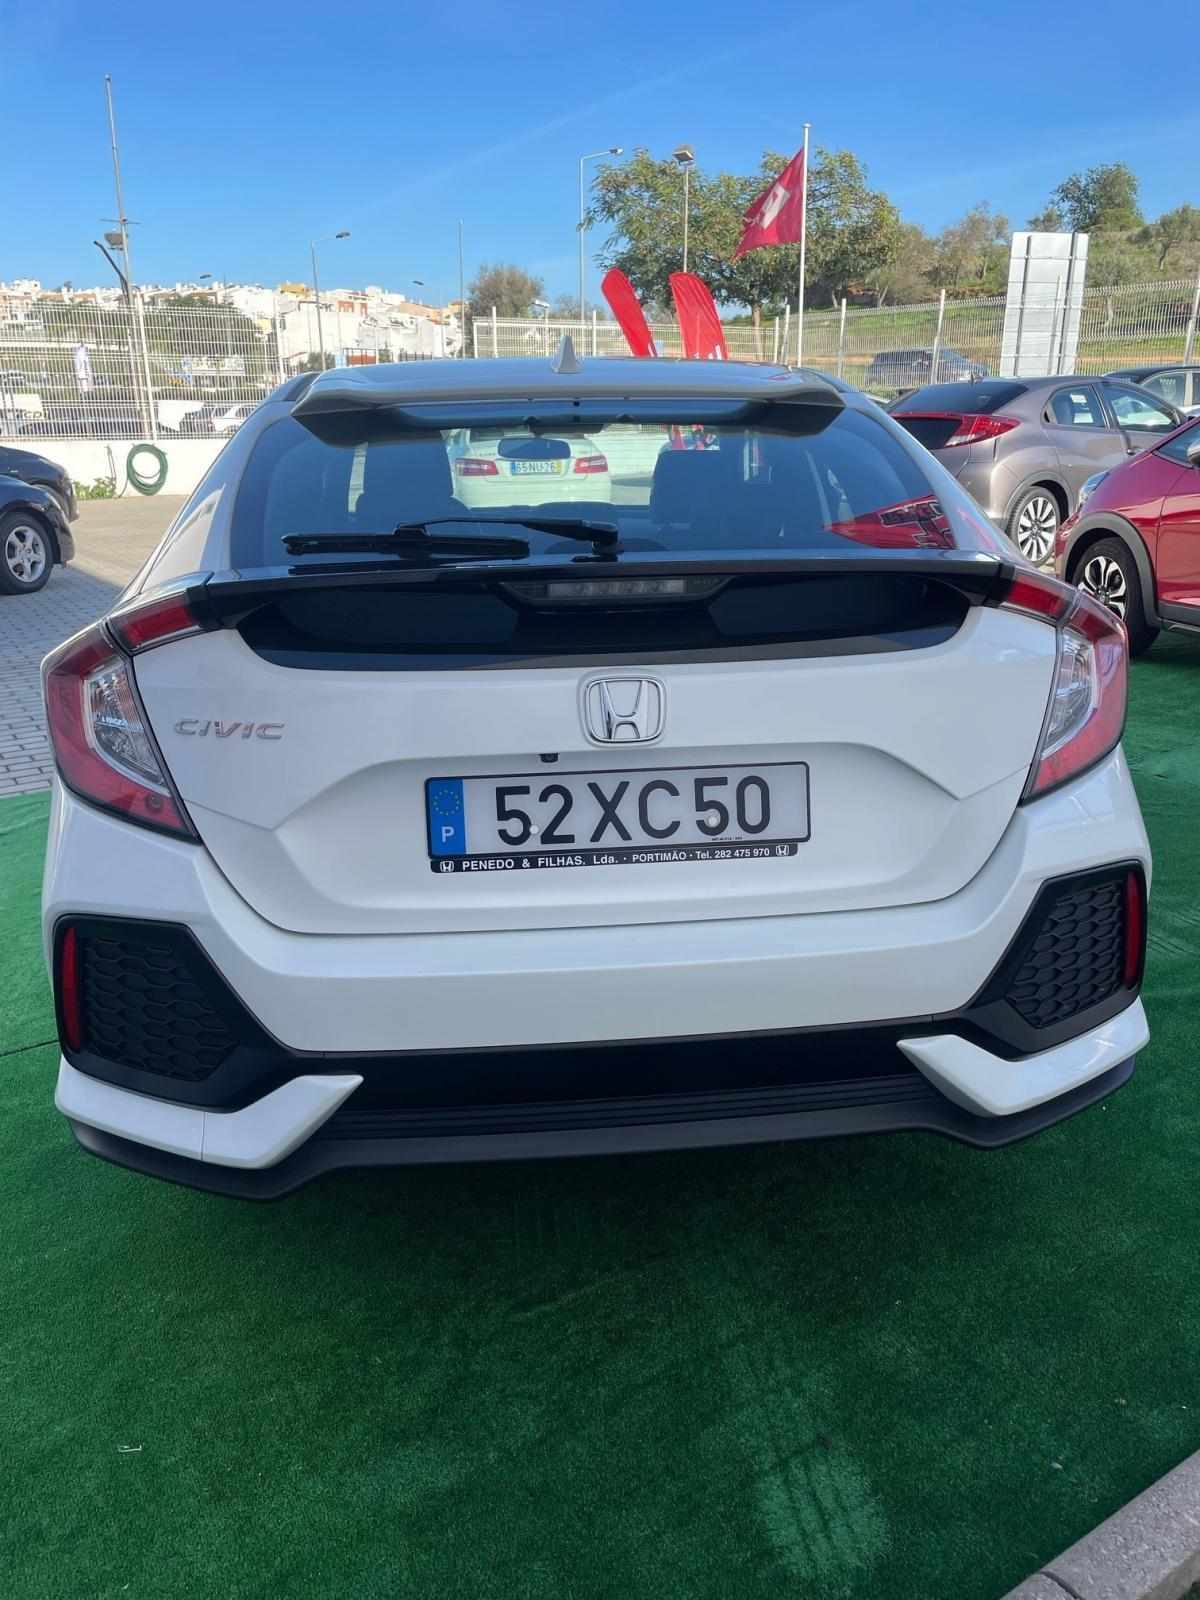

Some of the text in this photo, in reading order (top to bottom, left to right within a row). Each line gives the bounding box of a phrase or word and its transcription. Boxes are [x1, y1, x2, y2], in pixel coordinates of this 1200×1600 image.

[174, 719, 284, 740] CIVIC
[441, 826, 455, 843] P
[462, 858, 515, 871] PENEDO
[521, 858, 531, 869] &
[593, 854, 619, 865] Lda.
[632, 850, 687, 863] PORTIMÃO
[695, 850, 713, 860] Tel.
[714, 850, 732, 859] 282
[733, 848, 751, 858] 475
[752, 847, 770, 857] 970
